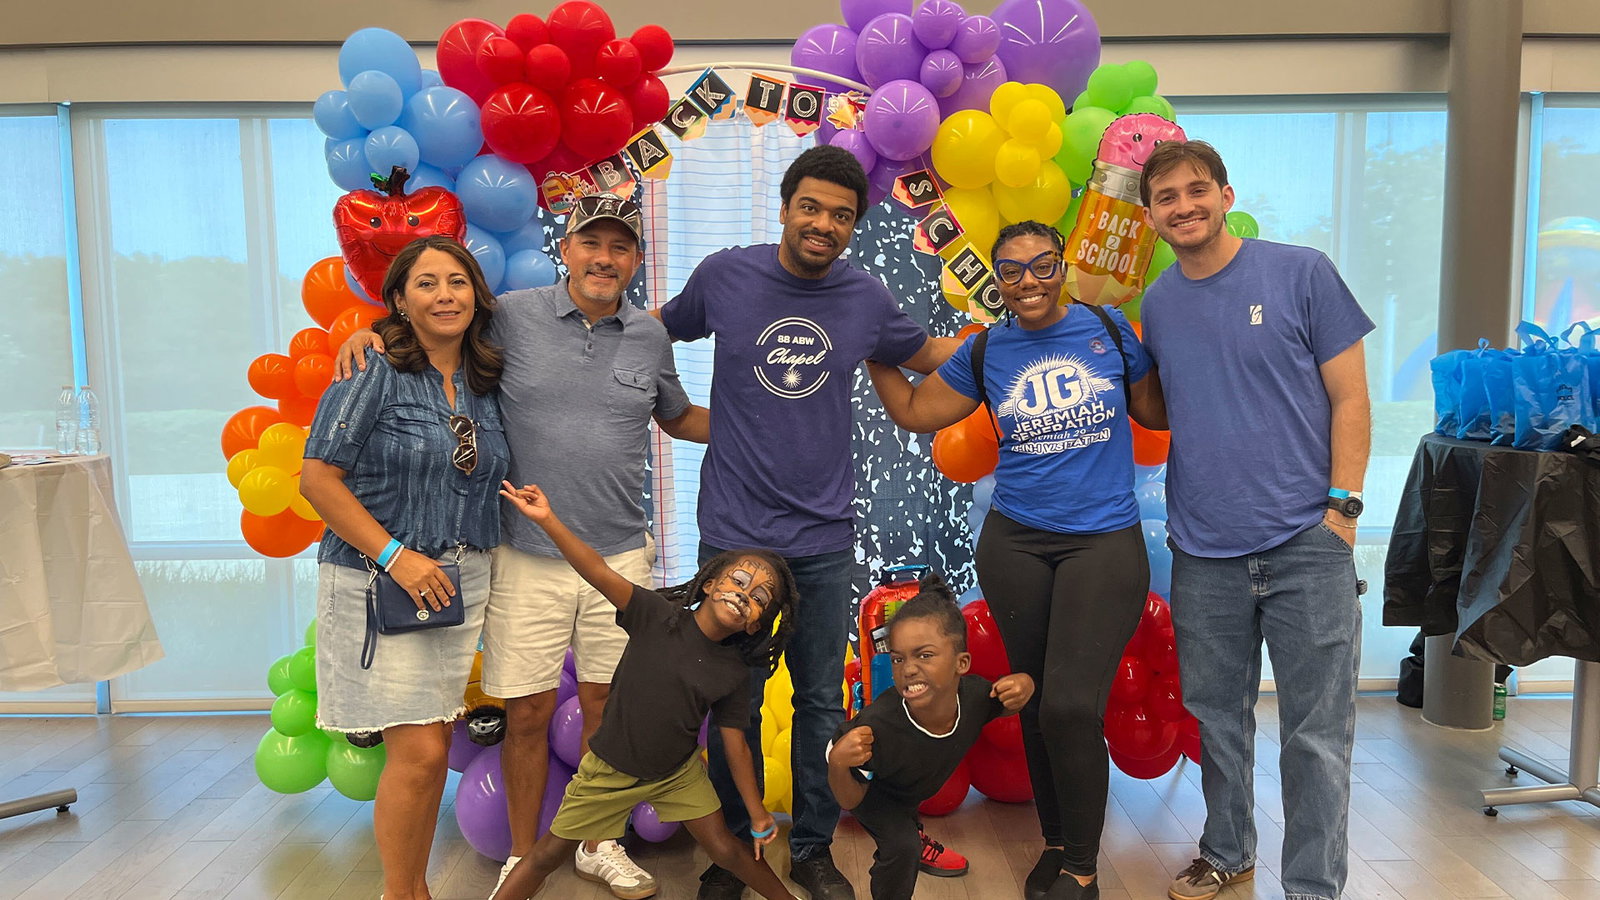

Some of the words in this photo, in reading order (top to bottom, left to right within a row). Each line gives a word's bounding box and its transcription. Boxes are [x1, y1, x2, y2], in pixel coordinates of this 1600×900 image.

[598, 78, 726, 188] BACK
[759, 80, 818, 118] TO
[1097, 211, 1142, 239] BACK
[1077, 239, 1138, 275] SCHOOL
[1107, 236, 1119, 249] 2
[777, 335, 790, 344] 88
[792, 336, 814, 346] ABW
[766, 347, 827, 370] Chapel
[1017, 365, 1084, 416] JG
[1011, 407, 1116, 441] GENERATION
[1013, 400, 1104, 434] JEREMIAH
[1028, 431, 1071, 442] emiah
